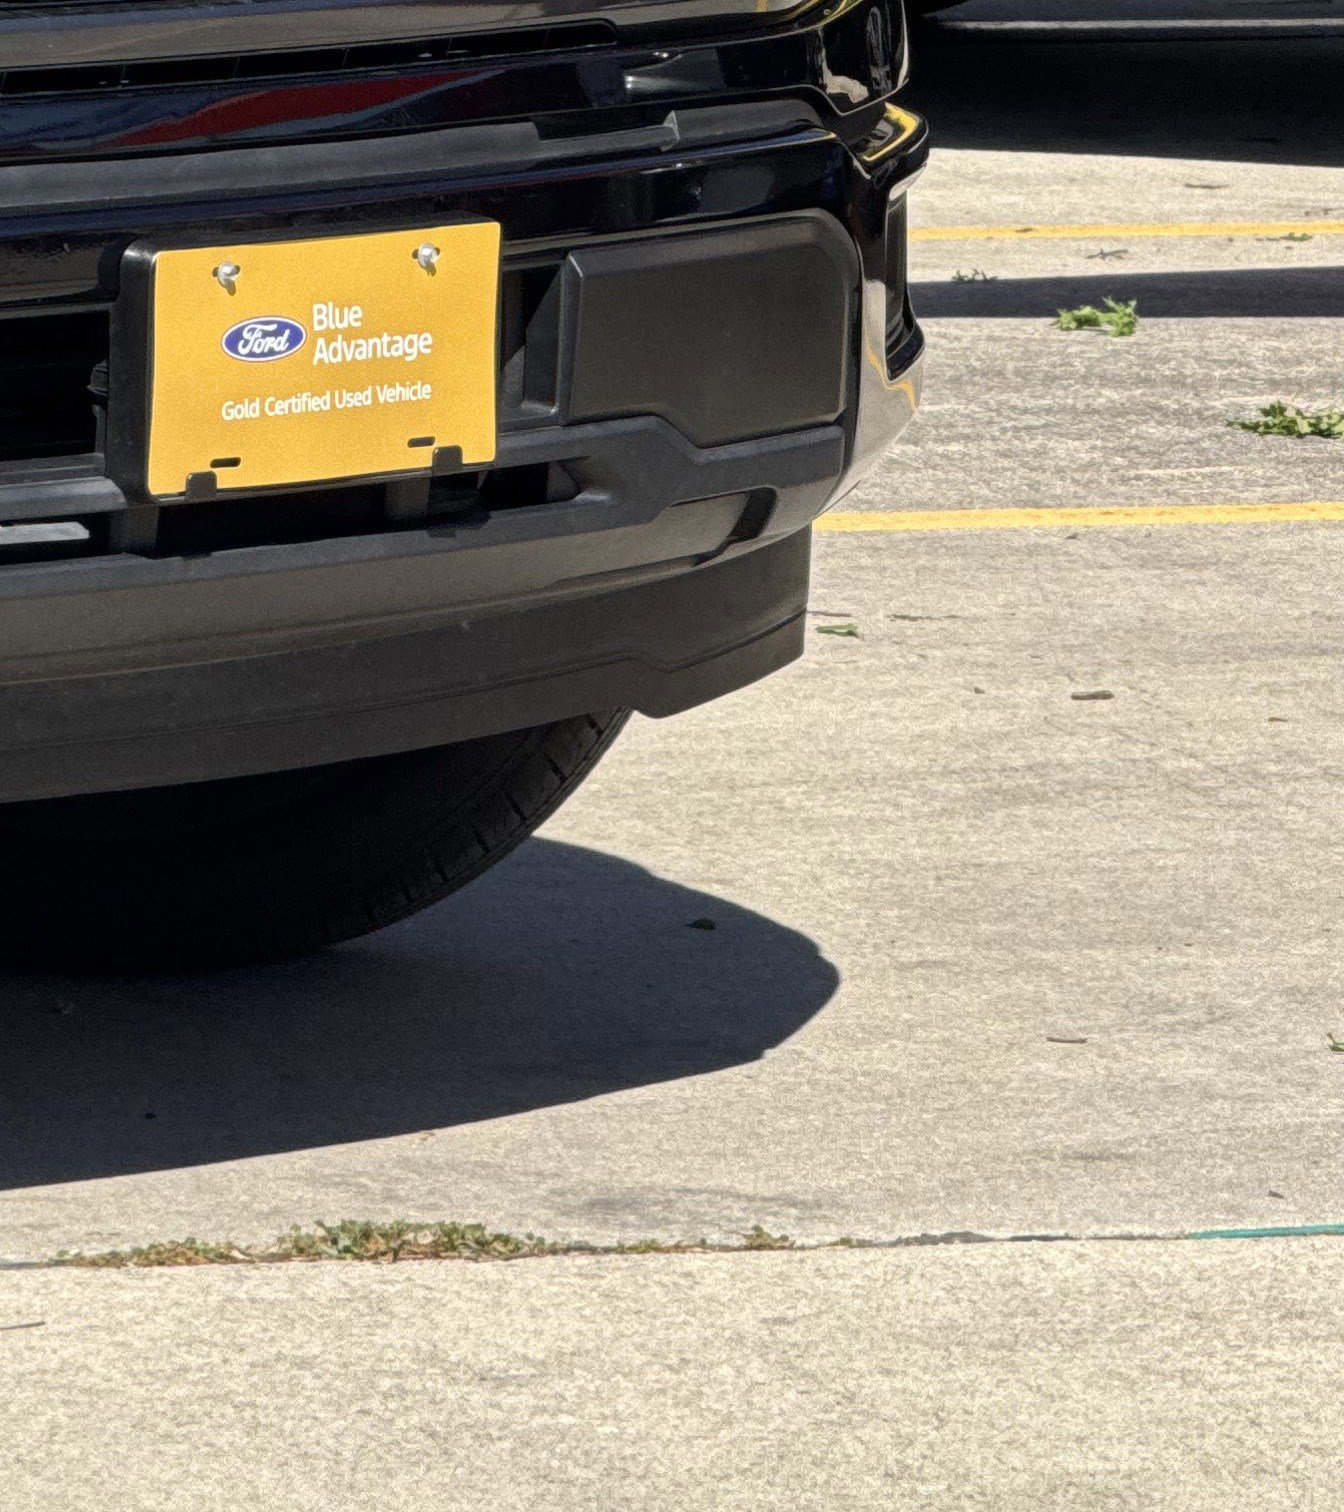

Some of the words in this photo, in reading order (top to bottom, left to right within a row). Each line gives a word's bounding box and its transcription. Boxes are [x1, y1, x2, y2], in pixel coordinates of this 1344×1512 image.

[312, 302, 363, 332] Blue
[238, 323, 291, 355] Ford
[312, 330, 433, 365] Advantage
[221, 395, 260, 421] Gold
[264, 390, 331, 417] Certified
[334, 385, 372, 409] Used
[375, 380, 432, 404] Vehicle
